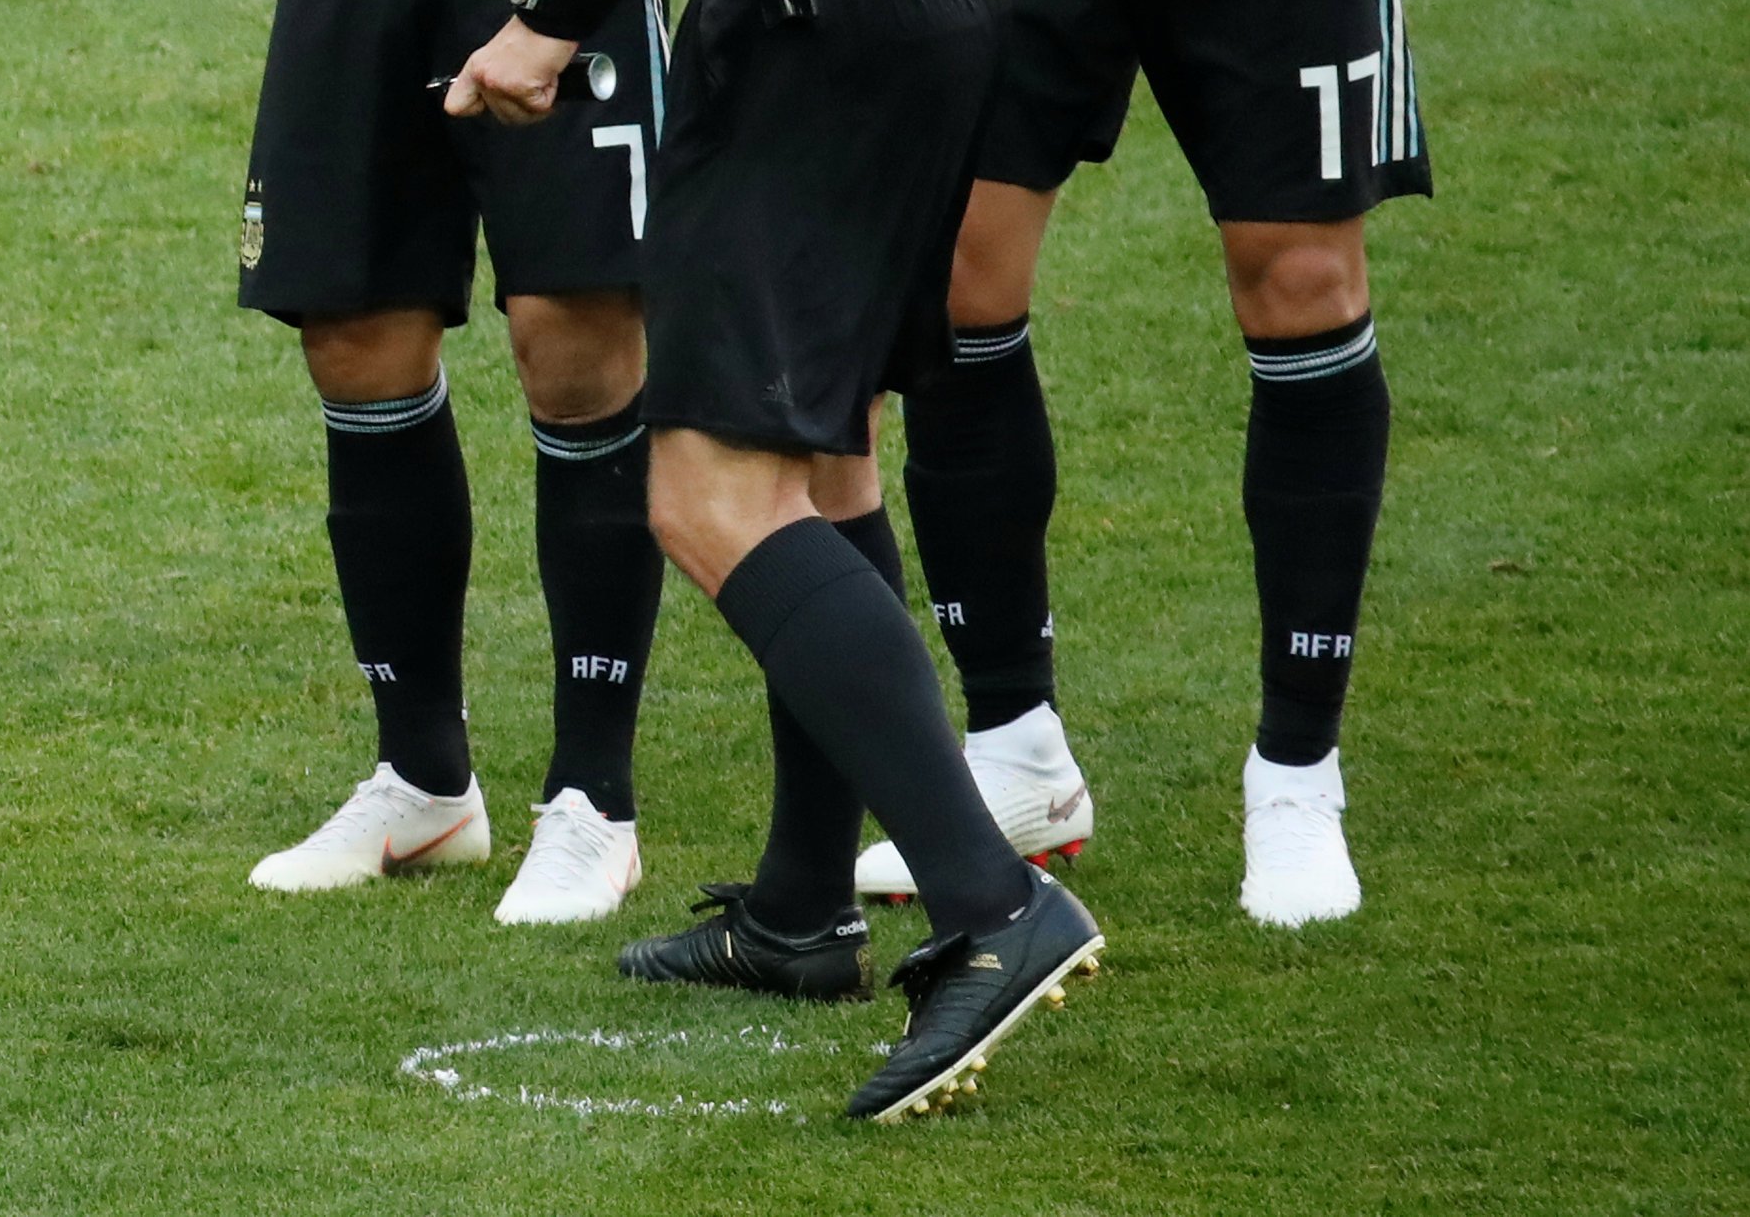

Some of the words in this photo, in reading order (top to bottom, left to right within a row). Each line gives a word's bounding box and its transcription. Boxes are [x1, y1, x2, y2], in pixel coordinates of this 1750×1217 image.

[1299, 51, 1381, 180] 17
[591, 124, 648, 240] 7
[932, 602, 966, 626] FA
[1290, 631, 1352, 658] AFA
[357, 663, 397, 682] FA
[571, 655, 628, 685] AFA
[835, 919, 868, 936] adid
